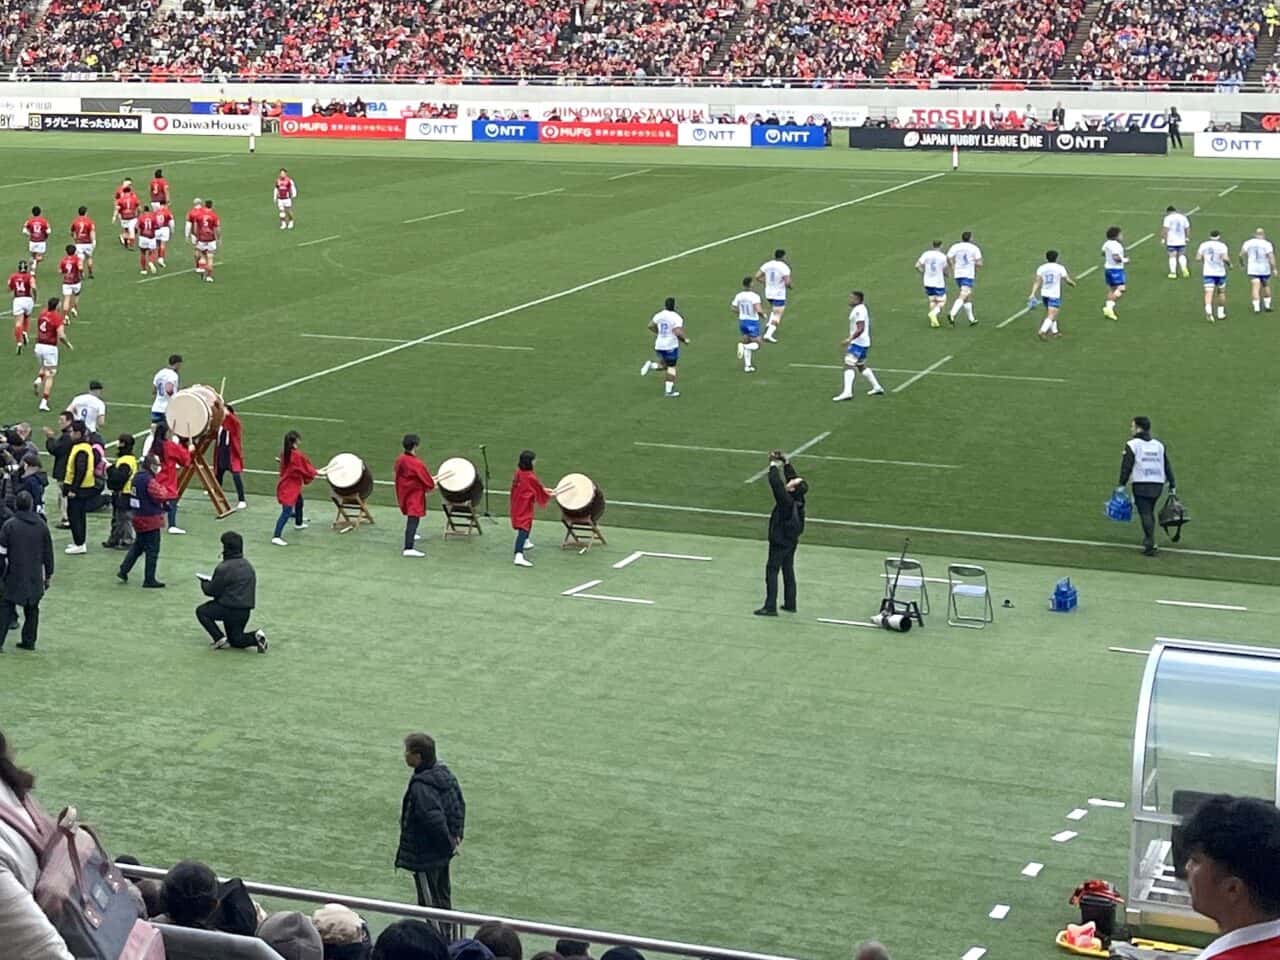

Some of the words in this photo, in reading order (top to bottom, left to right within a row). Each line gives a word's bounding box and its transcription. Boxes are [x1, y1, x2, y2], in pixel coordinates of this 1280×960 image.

[912, 109, 1010, 128] TOSHI
[299, 122, 328, 132] MUFG
[433, 124, 458, 136] NTT
[500, 124, 526, 137] NTT
[560, 127, 592, 138] MUFG
[709, 131, 735, 141] NTT
[782, 131, 810, 143] NTT
[920, 133, 949, 146] JAPAN
[982, 135, 1019, 147] LEAGUE
[1020, 134, 1043, 149] ONE
[1075, 136, 1108, 149] NTT
[1231, 140, 1263, 151] NTT
